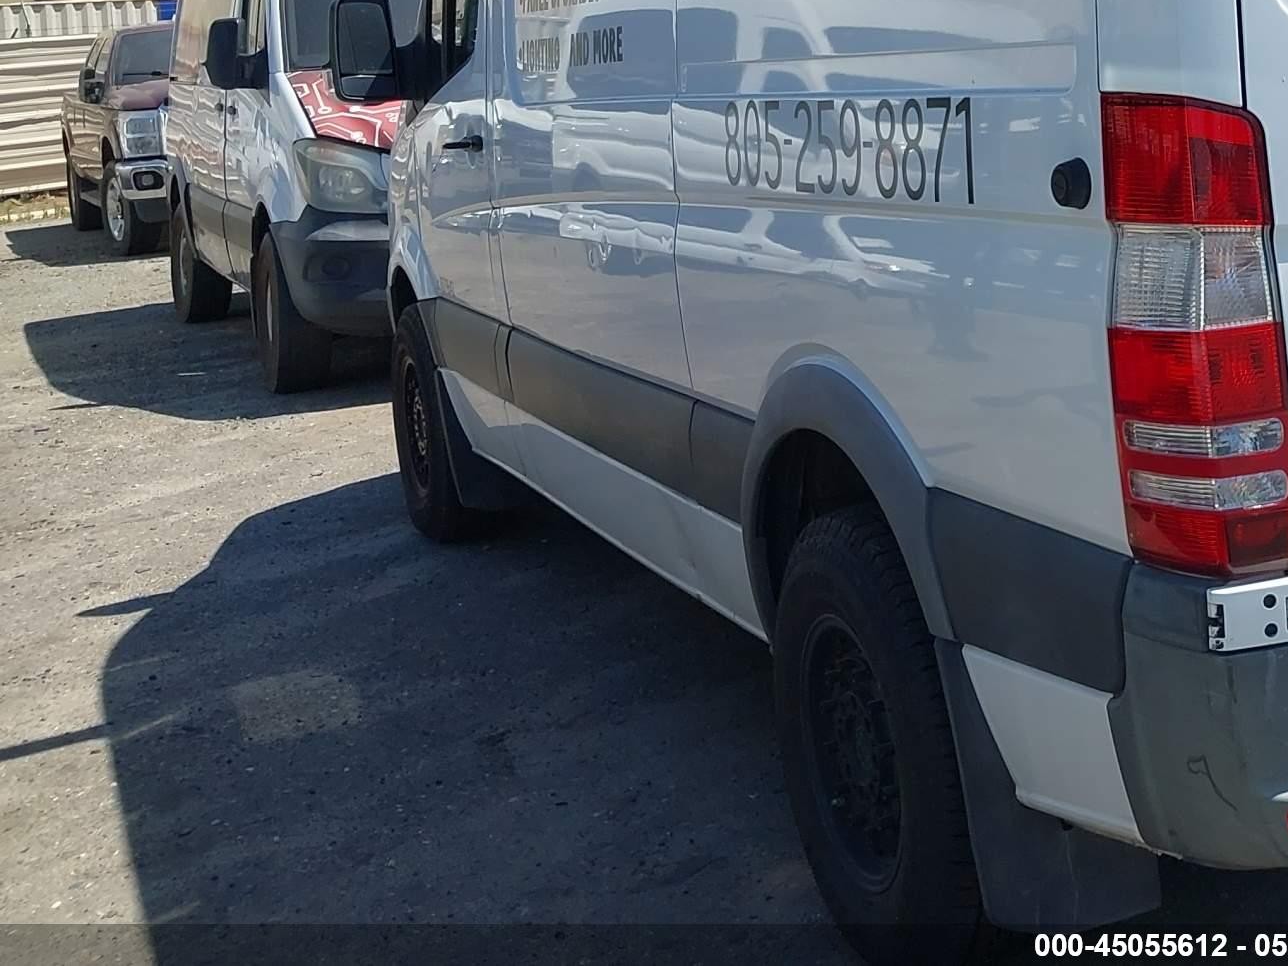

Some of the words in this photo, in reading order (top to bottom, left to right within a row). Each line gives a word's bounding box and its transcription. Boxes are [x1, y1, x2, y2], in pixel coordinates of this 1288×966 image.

[570, 26, 589, 67] AND
[593, 25, 623, 65] MORE
[725, 97, 975, 205] 805-259-8871
